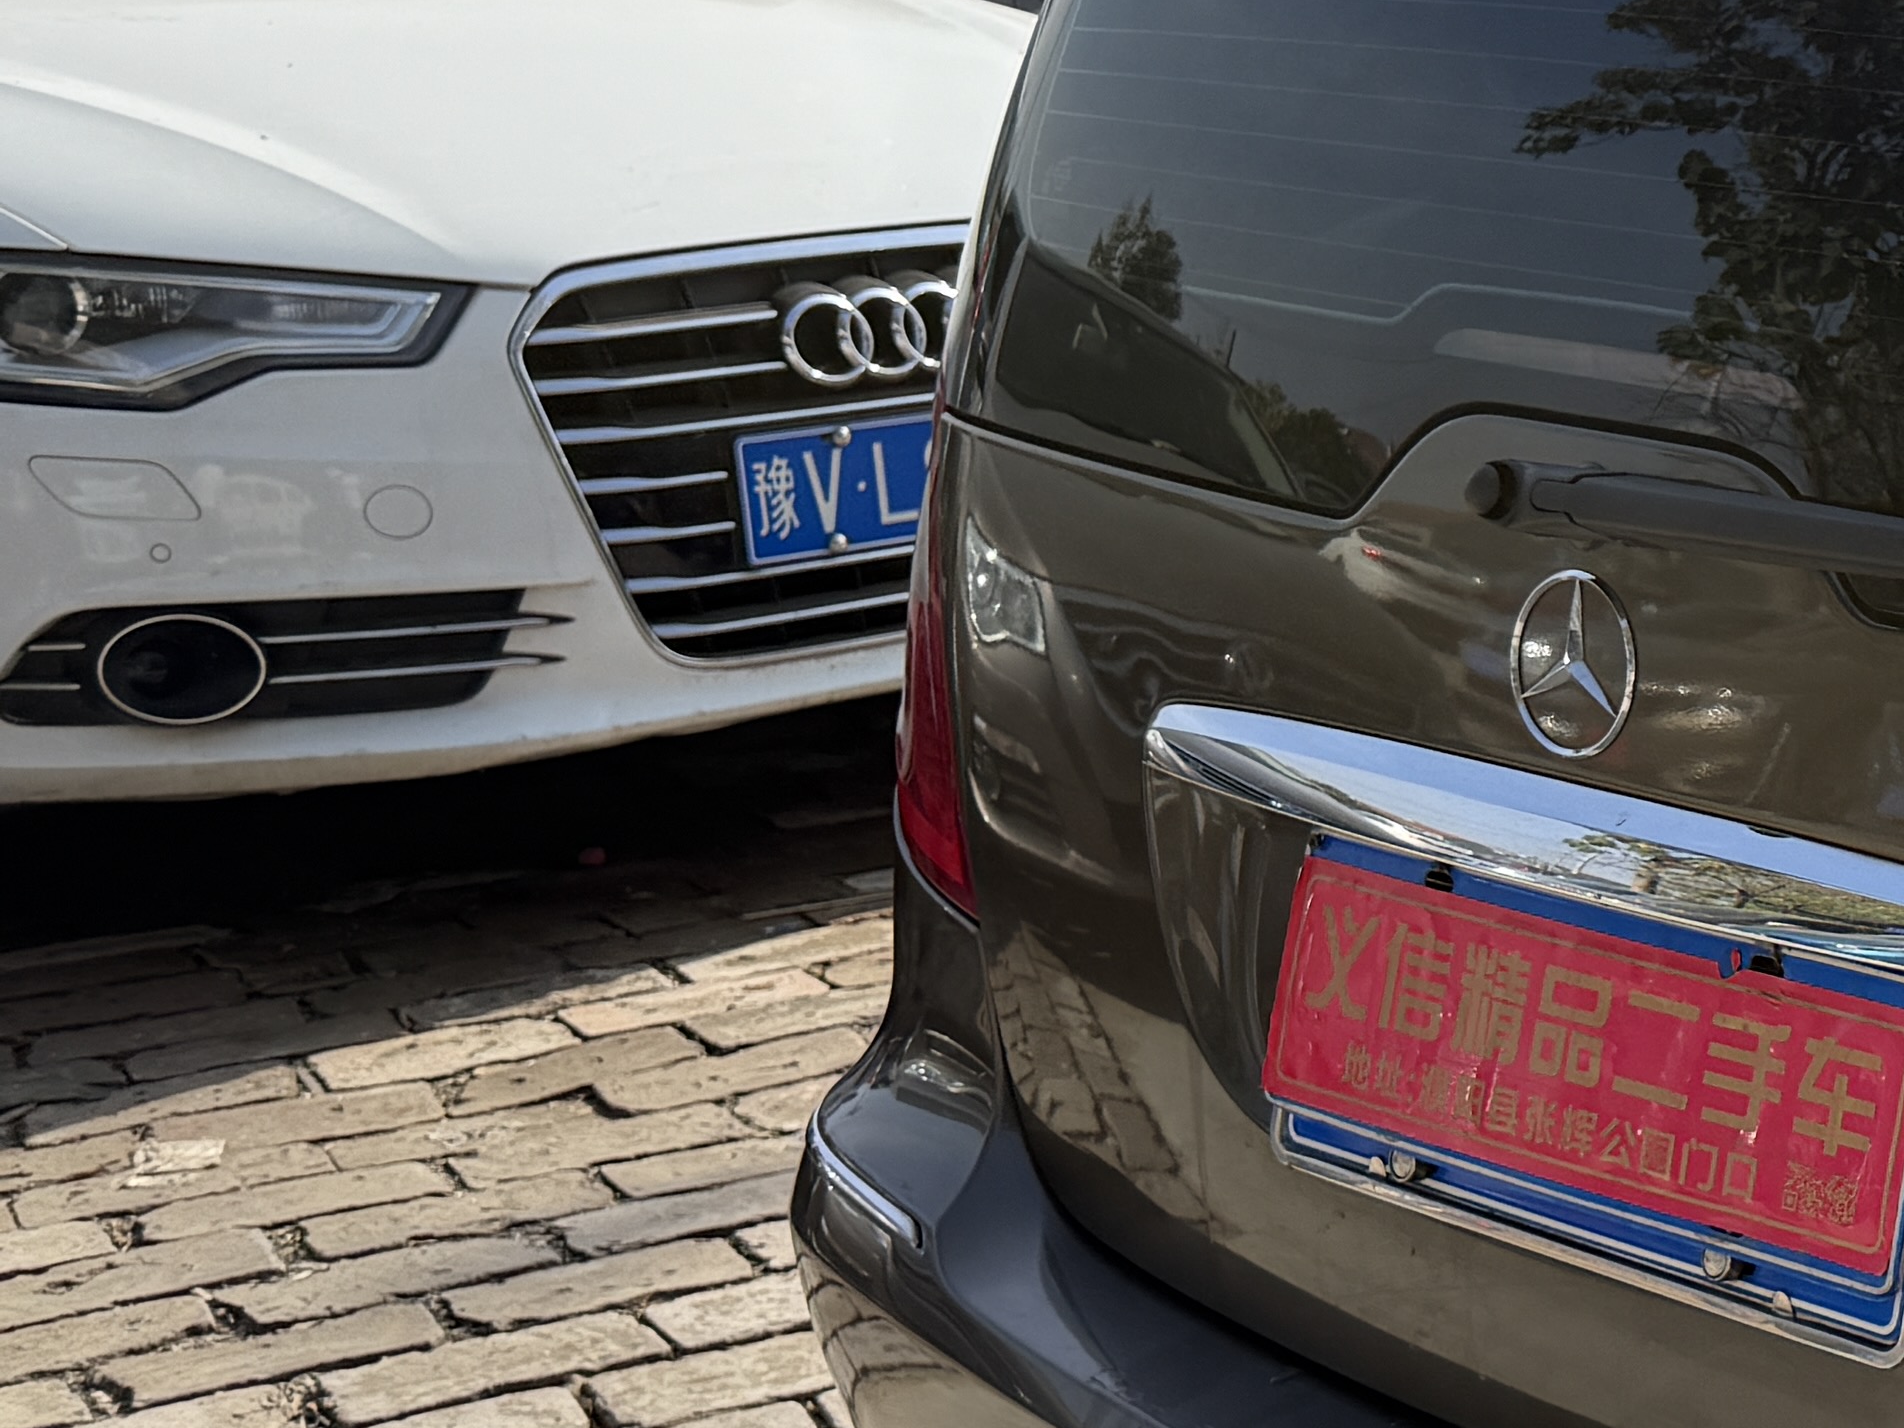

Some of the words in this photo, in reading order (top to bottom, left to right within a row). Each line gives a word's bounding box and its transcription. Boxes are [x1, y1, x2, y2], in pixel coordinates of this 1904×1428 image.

[751, 439, 931, 541] 豫V·L
[1304, 903, 1882, 1157] 义信精品二手车
